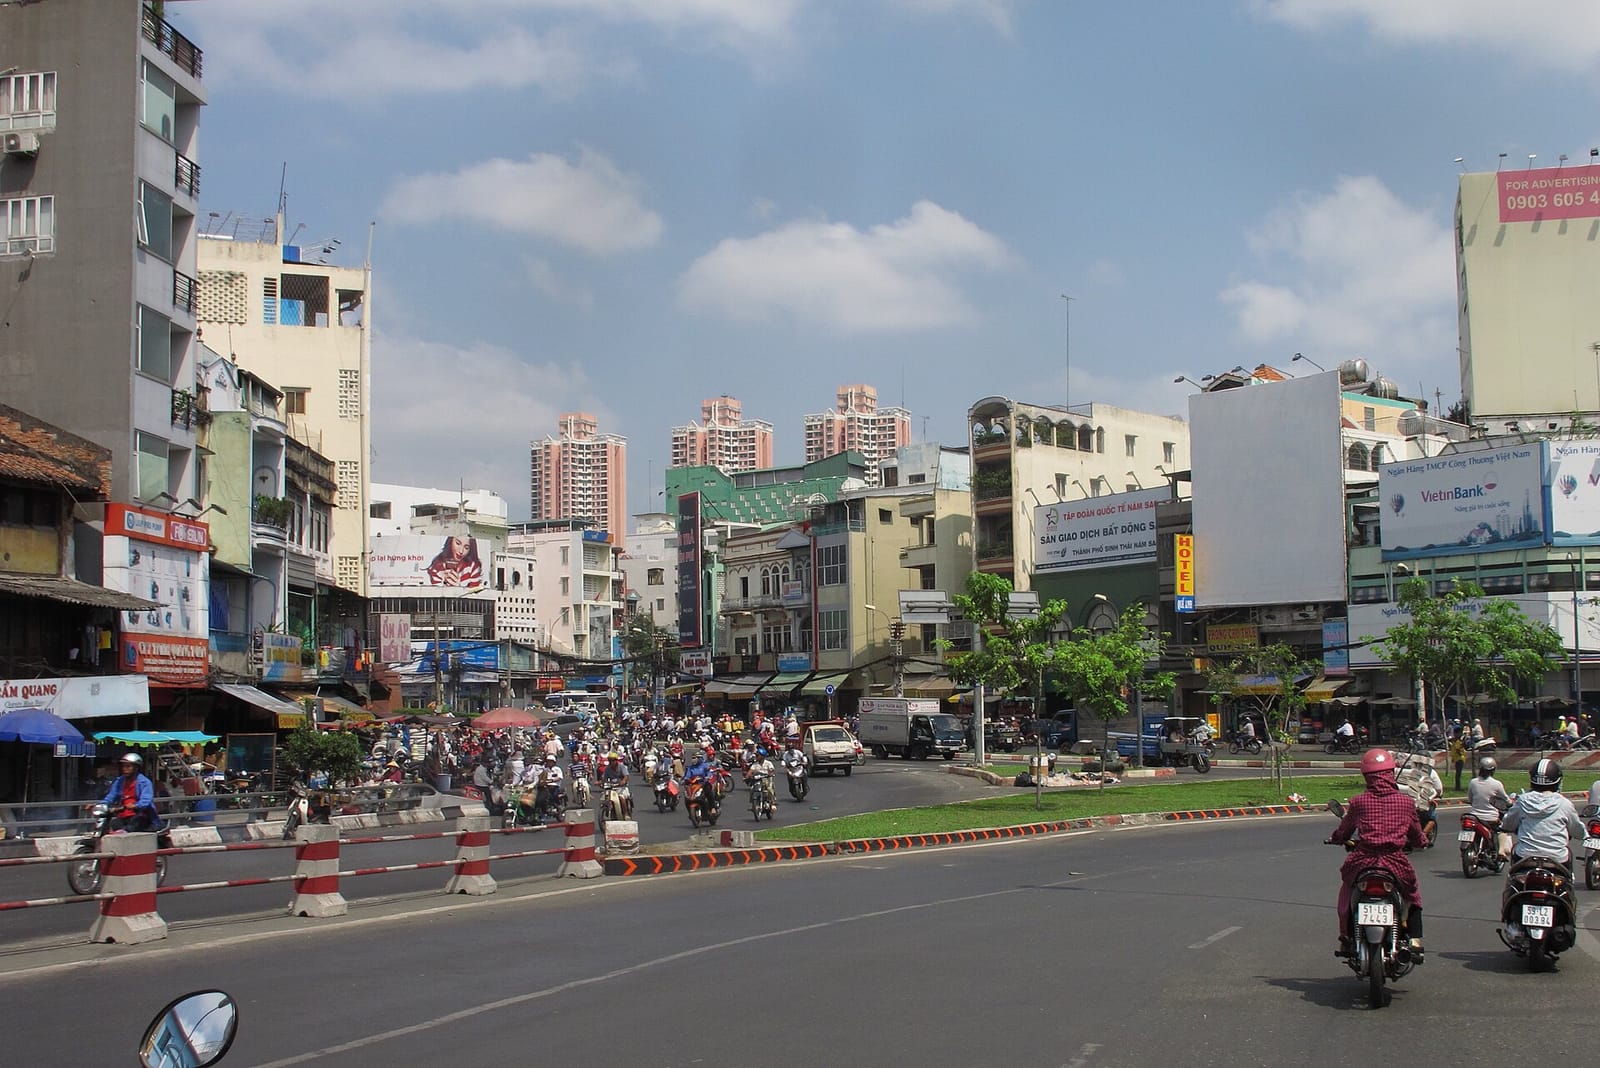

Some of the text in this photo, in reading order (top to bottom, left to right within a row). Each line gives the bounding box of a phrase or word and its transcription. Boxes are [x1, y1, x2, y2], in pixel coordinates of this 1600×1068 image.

[1506, 176, 1600, 190] FOR ADVERTISIN
[1507, 195, 1548, 210] 0903
[1553, 192, 1584, 207] 605
[1426, 461, 1448, 470] TMCP
[1512, 450, 1531, 459] Nam
[1420, 484, 1484, 503] VietinBank
[1058, 532, 1078, 543] GIAO
[1080, 528, 1100, 541] DỊCH
[1178, 536, 1191, 593] HOTEL
[22, 684, 57, 700] QUANG
[1363, 914, 1388, 924] 7443
